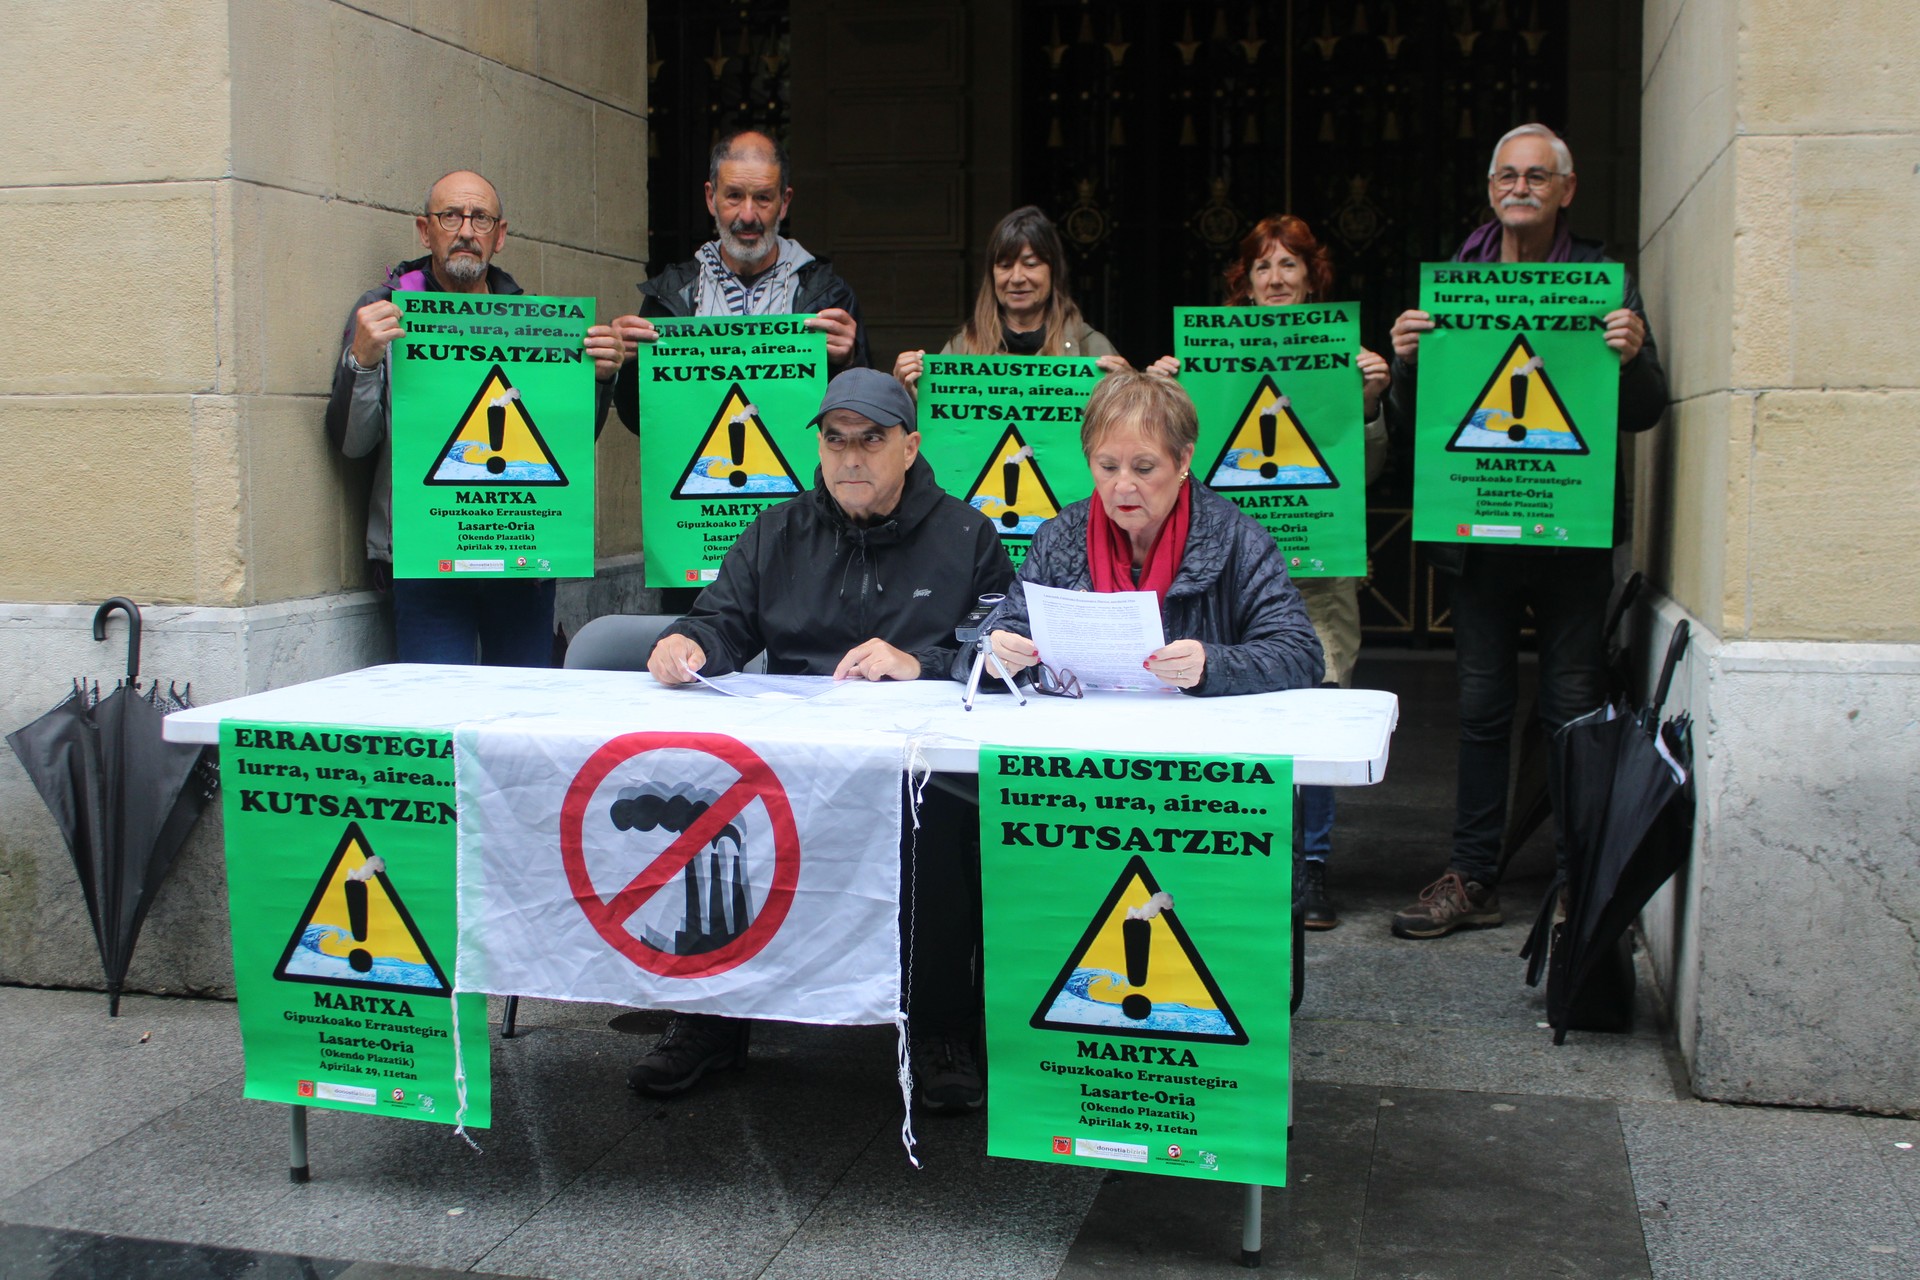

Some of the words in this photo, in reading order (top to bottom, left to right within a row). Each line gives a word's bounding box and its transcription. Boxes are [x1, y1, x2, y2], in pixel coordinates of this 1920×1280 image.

[1433, 270, 1611, 285] ERRAUSTEGIA
[1434, 292, 1489, 306] lurra,
[1496, 294, 1534, 306] ura,
[1539, 293, 1606, 305] airea...
[405, 299, 585, 318] ERRAUSTEGIA
[1184, 310, 1349, 328] ERRAUSTEGIA
[1434, 313, 1608, 331] KUTSATZEN
[406, 321, 464, 336] lurra,
[470, 325, 508, 337] ura,
[515, 325, 580, 338] airea...
[655, 322, 816, 337] ERRAUSTEGIA
[1184, 335, 1234, 348] lurra,
[1240, 335, 1278, 347] ura,
[1283, 334, 1345, 345] airea...
[406, 344, 583, 363] KUTSATZEN
[651, 344, 705, 357] lurra,
[710, 346, 747, 356] ura,
[751, 344, 812, 355] airea...
[929, 362, 1095, 377] ERRAUSTEGIA
[1184, 352, 1350, 372] KUTSATZEN
[652, 363, 817, 382] KUTSATZEN
[930, 383, 982, 397] lurra,
[988, 386, 1024, 398] ura,
[1028, 384, 1090, 397] airea...
[1476, 458, 1556, 472] MARTXA
[1450, 474, 1513, 483] Gipuzkoako
[1516, 475, 1582, 486] Erraustegira
[456, 492, 537, 504] MARTXA
[1477, 488, 1553, 499] Lasarte-Oria
[429, 508, 493, 517] Gipuzkoako
[497, 508, 562, 518] Erraustegira
[701, 504, 773, 516] MARTX
[1270, 511, 1334, 519] Erraustegira
[458, 522, 535, 531] Lasarte-Oria
[677, 520, 737, 529] Gipuzkoako
[1266, 524, 1308, 533] te-Oria
[234, 728, 454, 758] ERRAUSTEGIA
[237, 758, 309, 782] lurra,
[315, 765, 367, 786] ura,
[373, 767, 456, 787] airea...
[997, 755, 1275, 785] ERRAUSTEGIA
[240, 789, 458, 825] KUTSATZEN
[1000, 788, 1086, 812] lurra,
[1095, 793, 1155, 815] ura,
[1163, 794, 1267, 815] airea...
[1001, 822, 1274, 857] KUTSATZEN
[313, 991, 414, 1018] MARTXA
[283, 1011, 362, 1028] Gipuzkoako
[365, 1019, 448, 1038] Erraustegira
[319, 1031, 414, 1053] Lasarte-Oria
[320, 1048, 365, 1061] (Okendo
[368, 1055, 415, 1068] Plazatik)
[1076, 1040, 1199, 1068] MARTXA
[319, 1061, 362, 1073] Apirilak
[365, 1067, 380, 1077] 29,
[383, 1070, 417, 1081] 11etan
[1040, 1060, 1134, 1080] Gipuzkoako
[1137, 1070, 1238, 1090] Erraustegira
[1080, 1083, 1196, 1107] Lasarte-Oria
[1081, 1101, 1135, 1116] (Okendo
[1137, 1108, 1196, 1123] Plazatik)
[1078, 1115, 1132, 1129] Apirilak
[1134, 1122, 1153, 1133] 29,
[1156, 1124, 1198, 1135] 11etan
